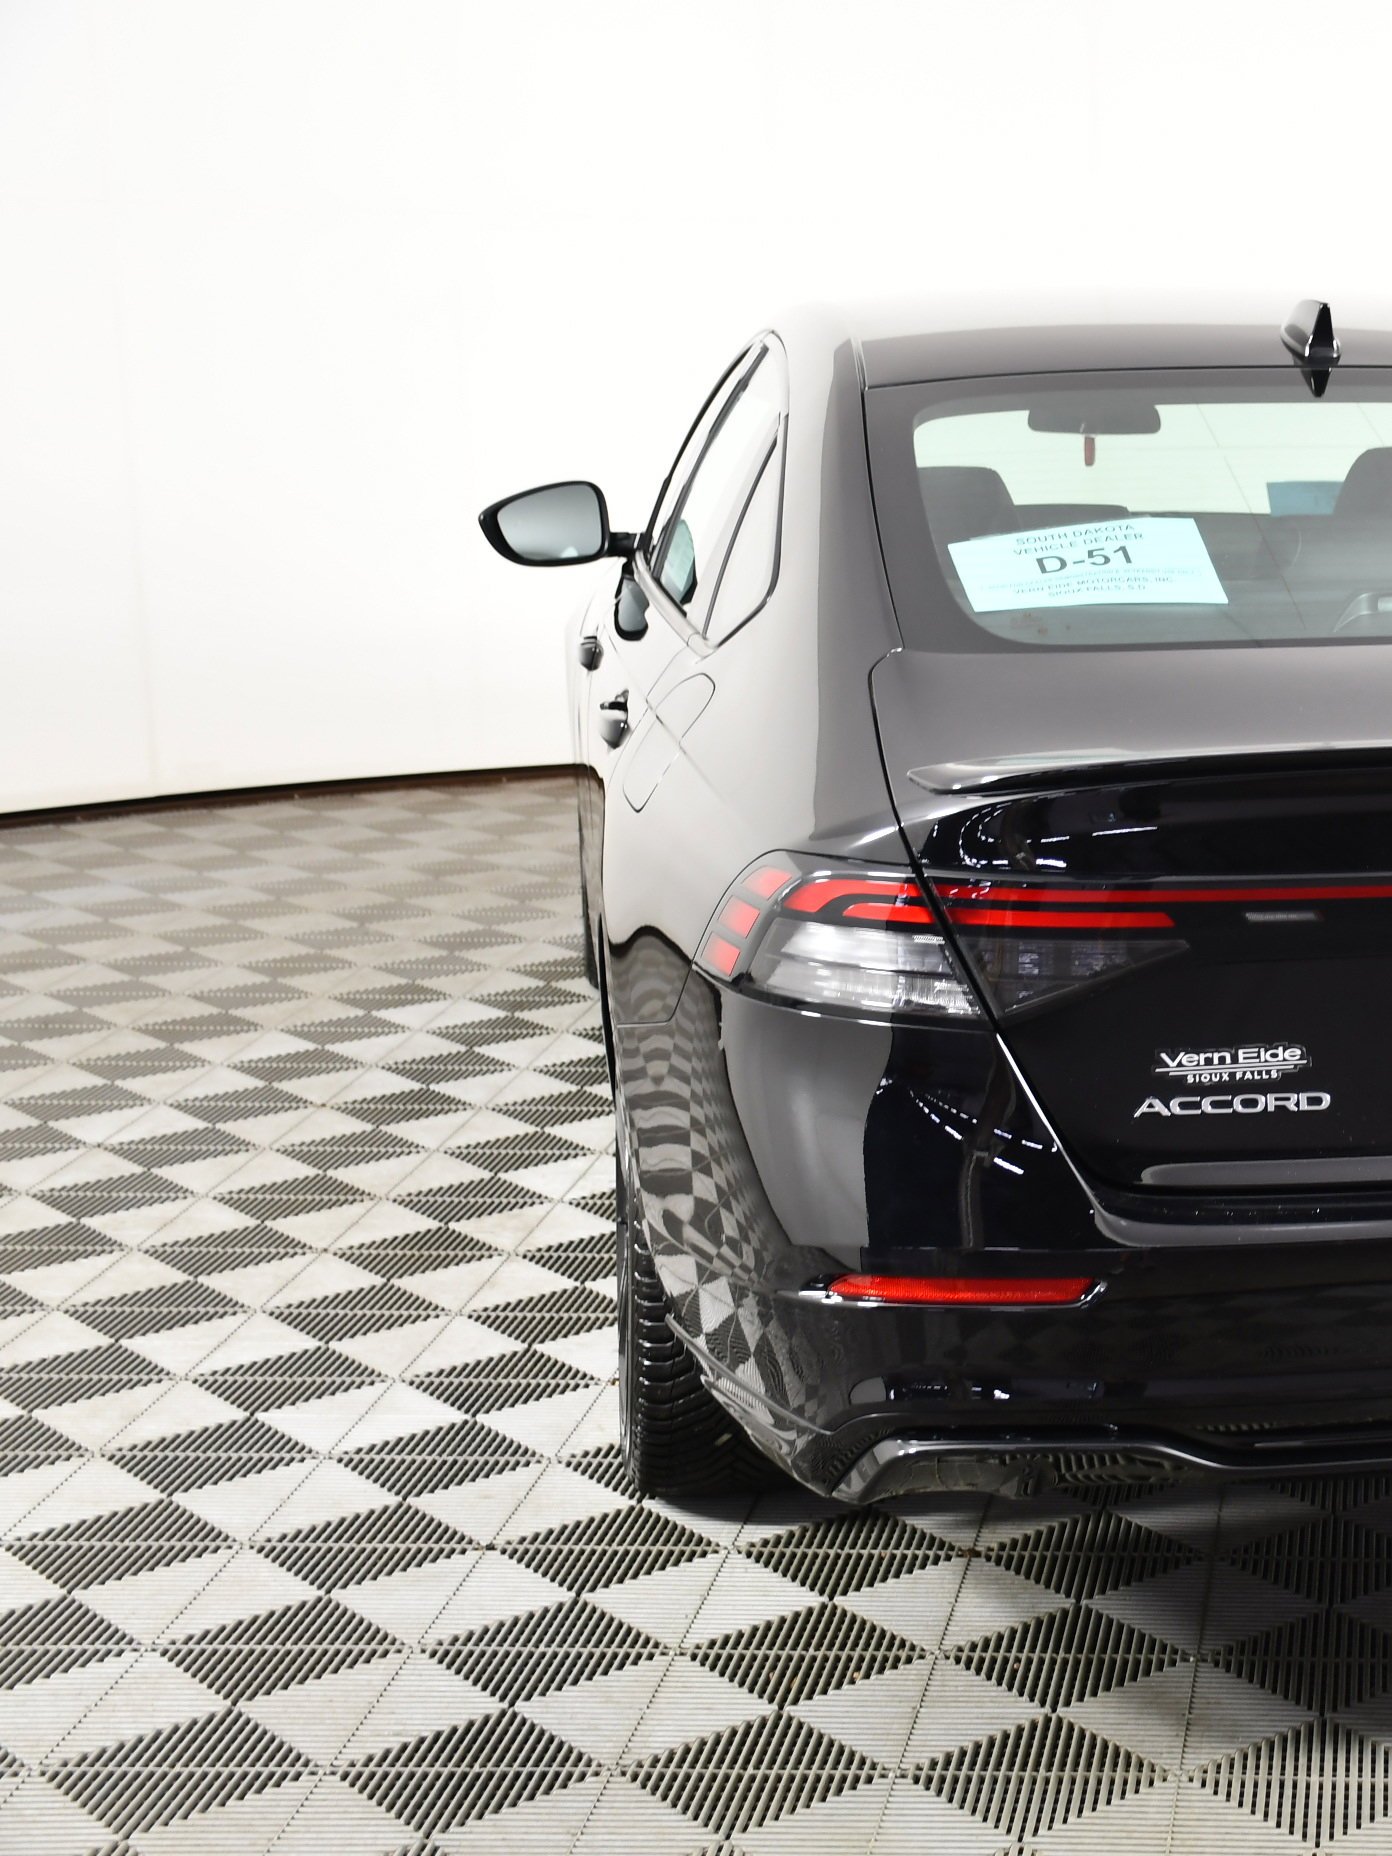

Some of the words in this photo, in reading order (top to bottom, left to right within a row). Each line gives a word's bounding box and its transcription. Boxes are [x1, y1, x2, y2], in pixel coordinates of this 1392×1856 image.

[1013, 541, 1077, 555] VEHICLE
[1083, 533, 1143, 546] DEALER
[1016, 533, 1068, 545] SOUTH
[1072, 524, 1135, 537] DAKOTA
[1036, 545, 1132, 574] D-51
[1160, 1051, 1231, 1067] Vern
[1238, 1046, 1302, 1063] Eide
[1187, 1072, 1229, 1083] SIOUX
[1236, 1070, 1278, 1081] FALLS
[1133, 1092, 1331, 1118] ACCORD
